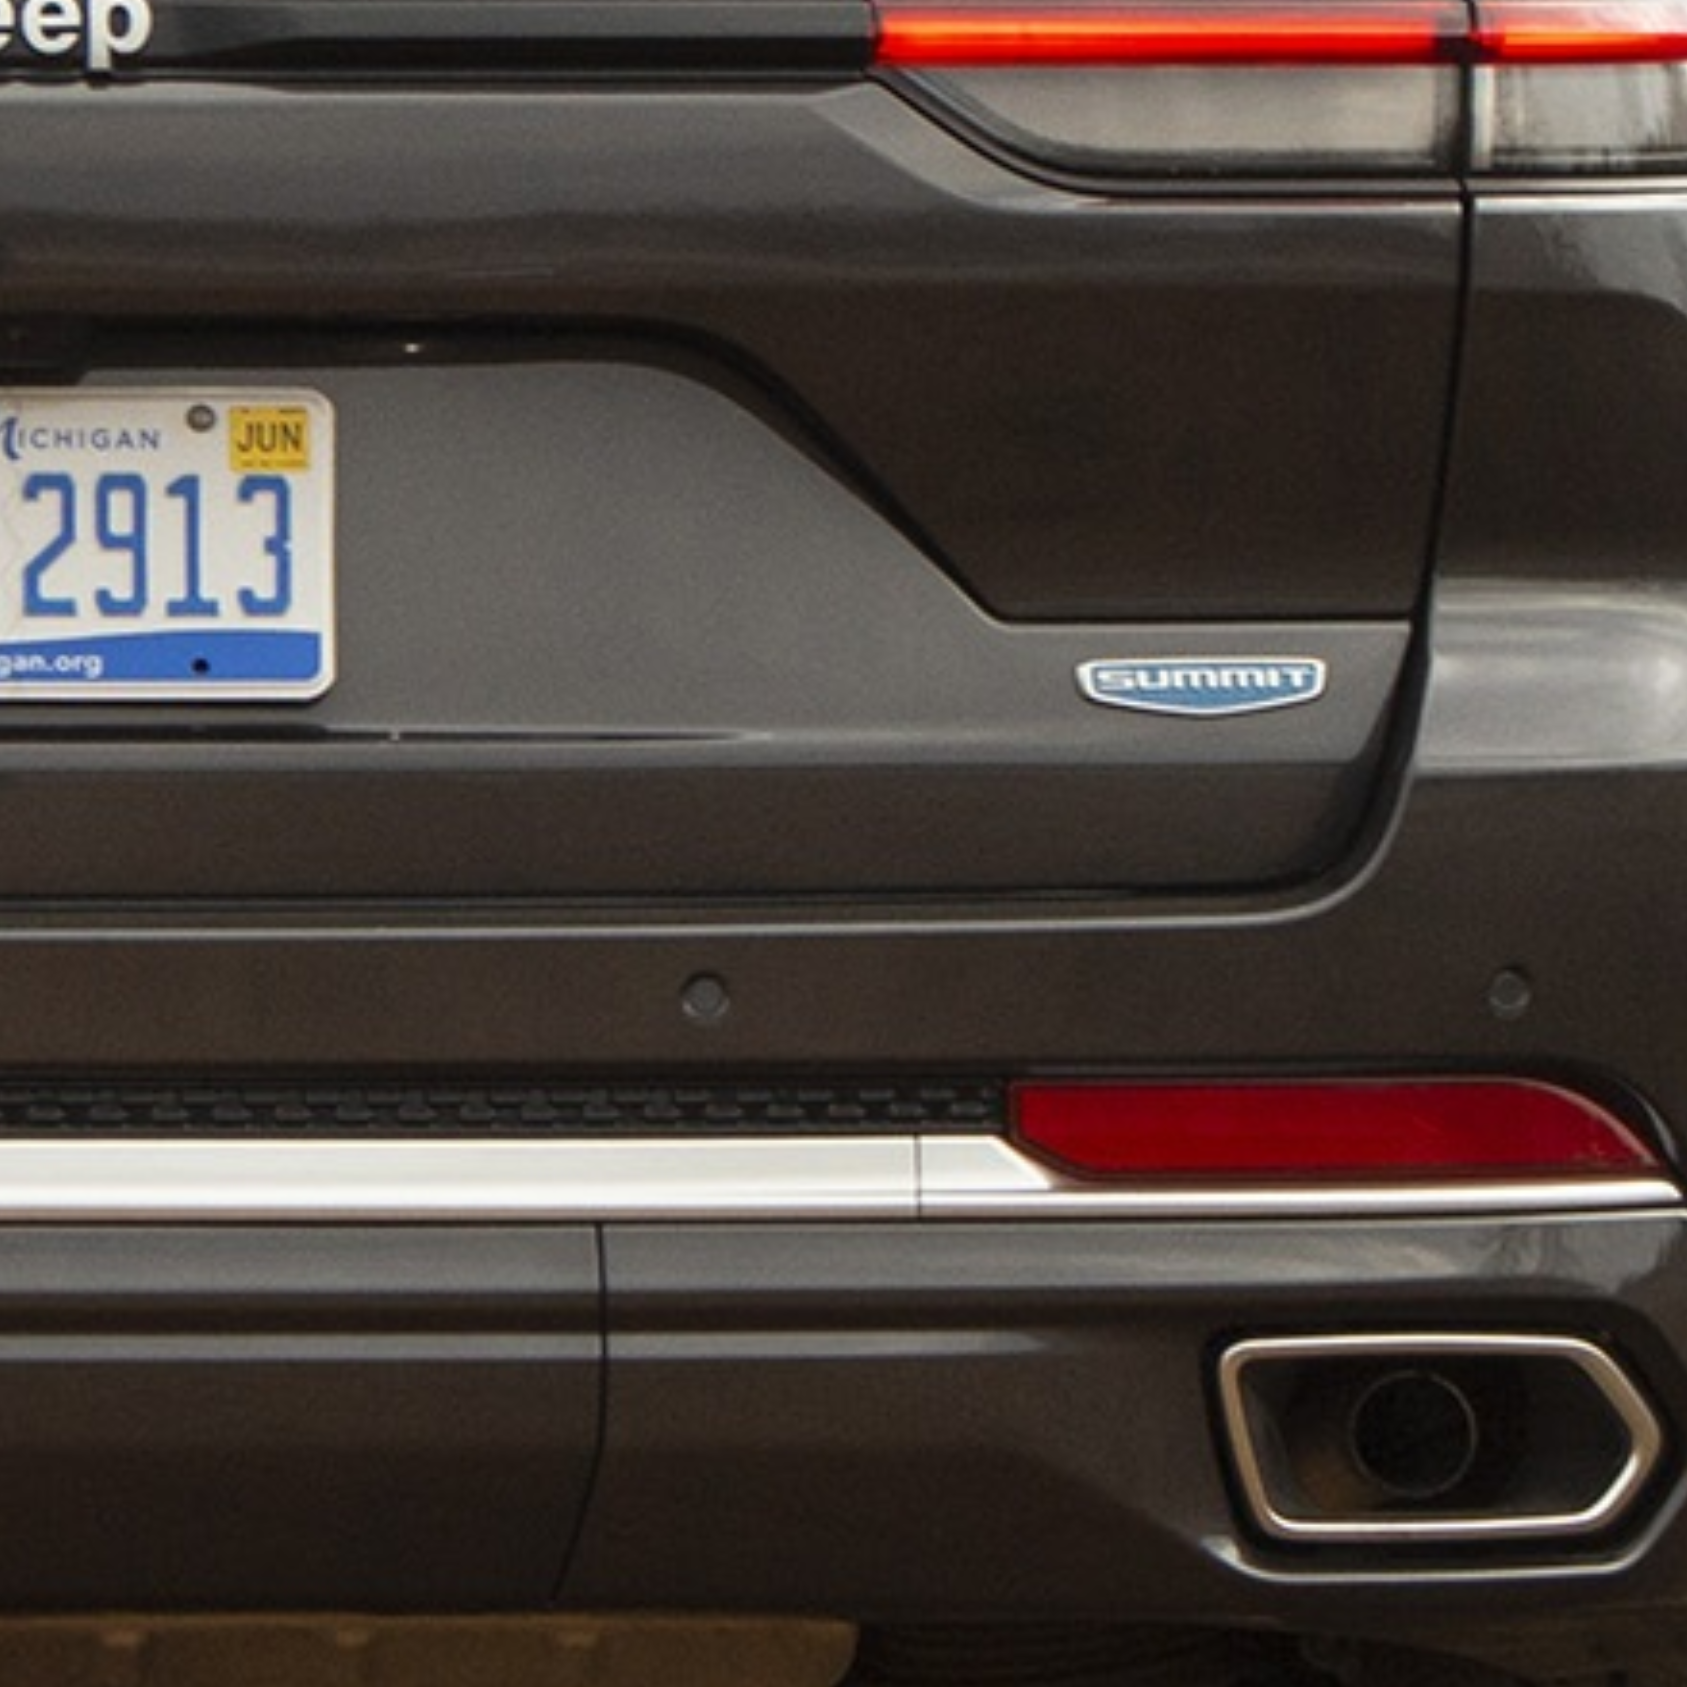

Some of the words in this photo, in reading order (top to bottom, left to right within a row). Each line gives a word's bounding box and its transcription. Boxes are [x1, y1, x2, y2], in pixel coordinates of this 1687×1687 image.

[237, 421, 303, 453] JUN
[22, 472, 294, 616] 2913
[1096, 667, 1312, 690] SUMMIT
